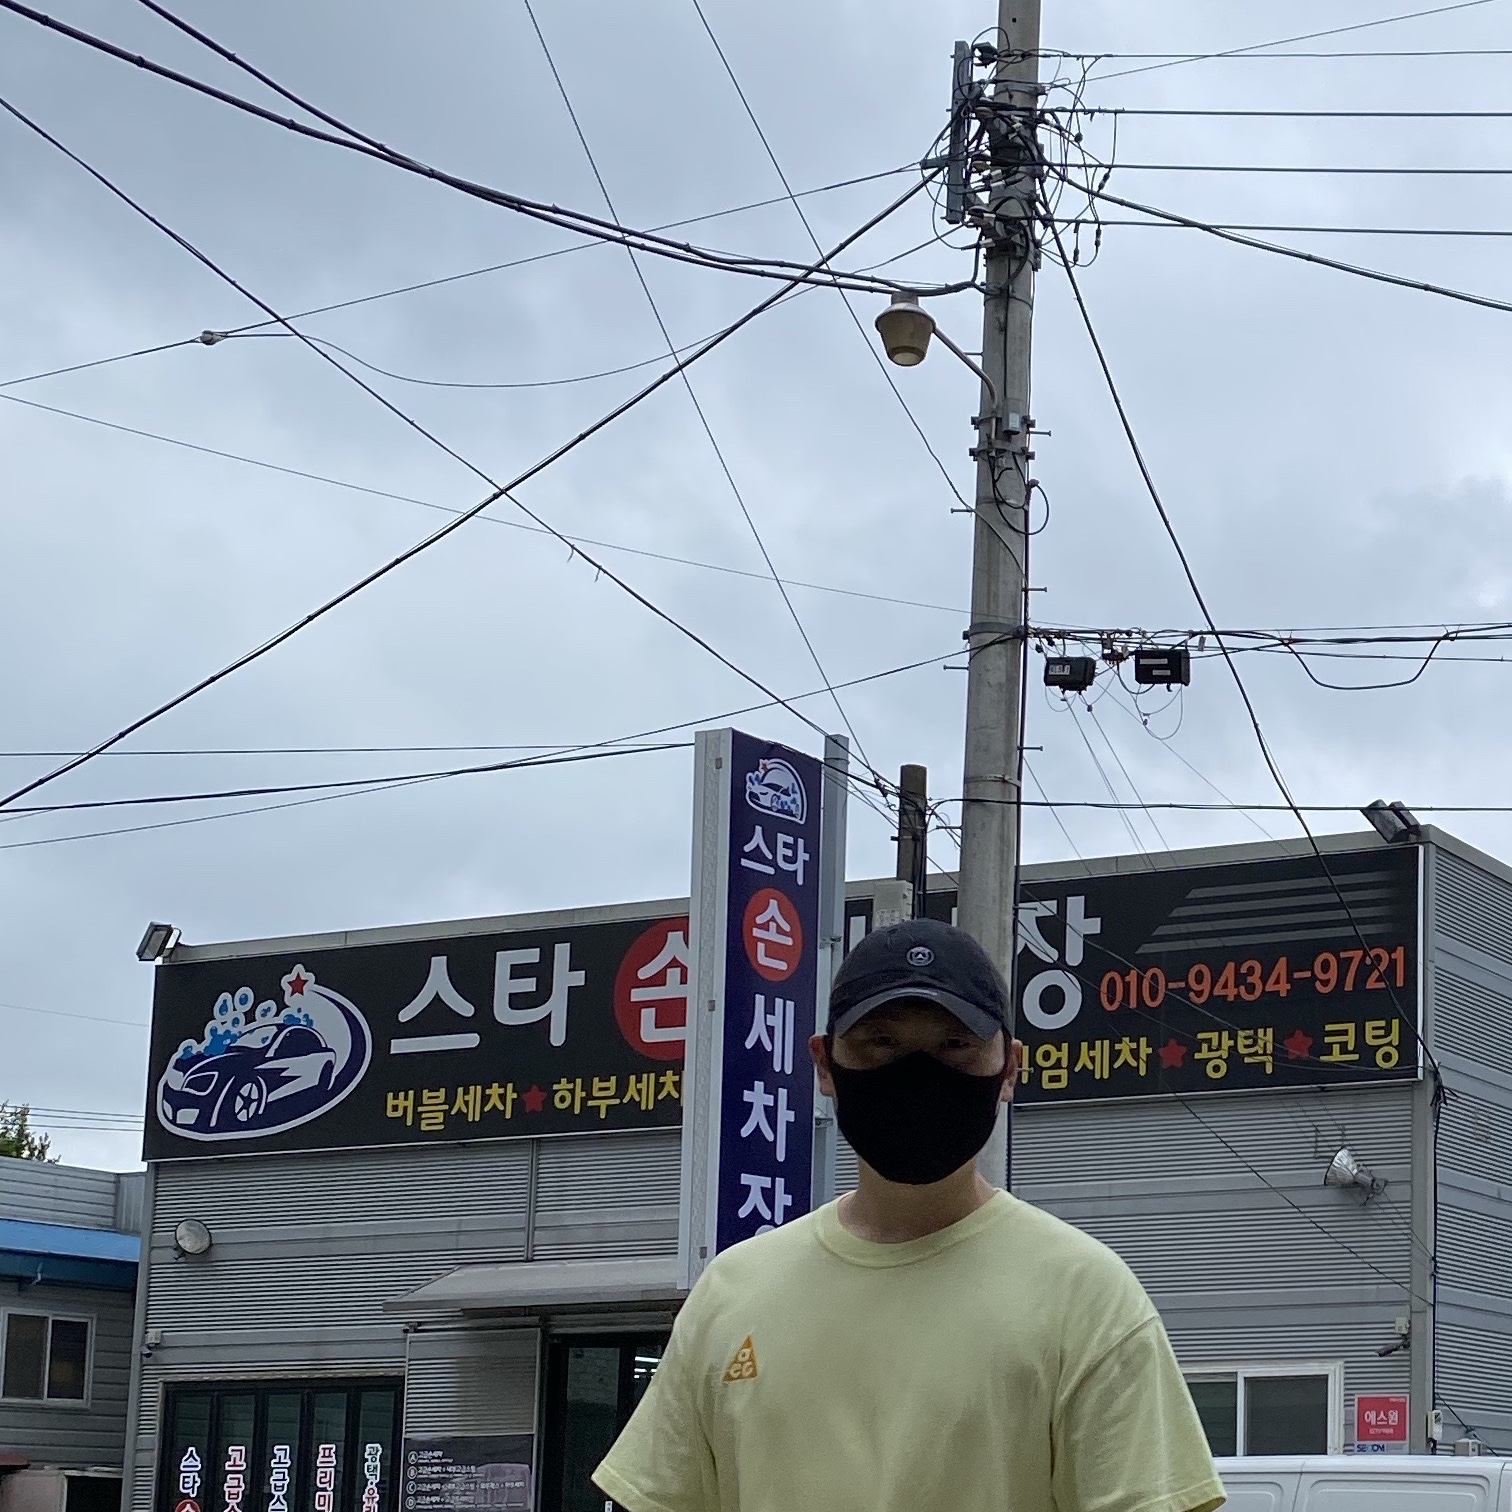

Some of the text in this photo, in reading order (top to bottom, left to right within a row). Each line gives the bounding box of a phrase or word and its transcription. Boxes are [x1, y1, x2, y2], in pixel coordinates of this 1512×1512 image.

[740, 825, 810, 886] 스타
[389, 942, 586, 1054] 스타
[1099, 945, 1406, 1012] 010-9434-9721
[386, 1082, 517, 1131] 버블세차
[1193, 1027, 1275, 1080] 광택
[1319, 1018, 1400, 1069] 코팅
